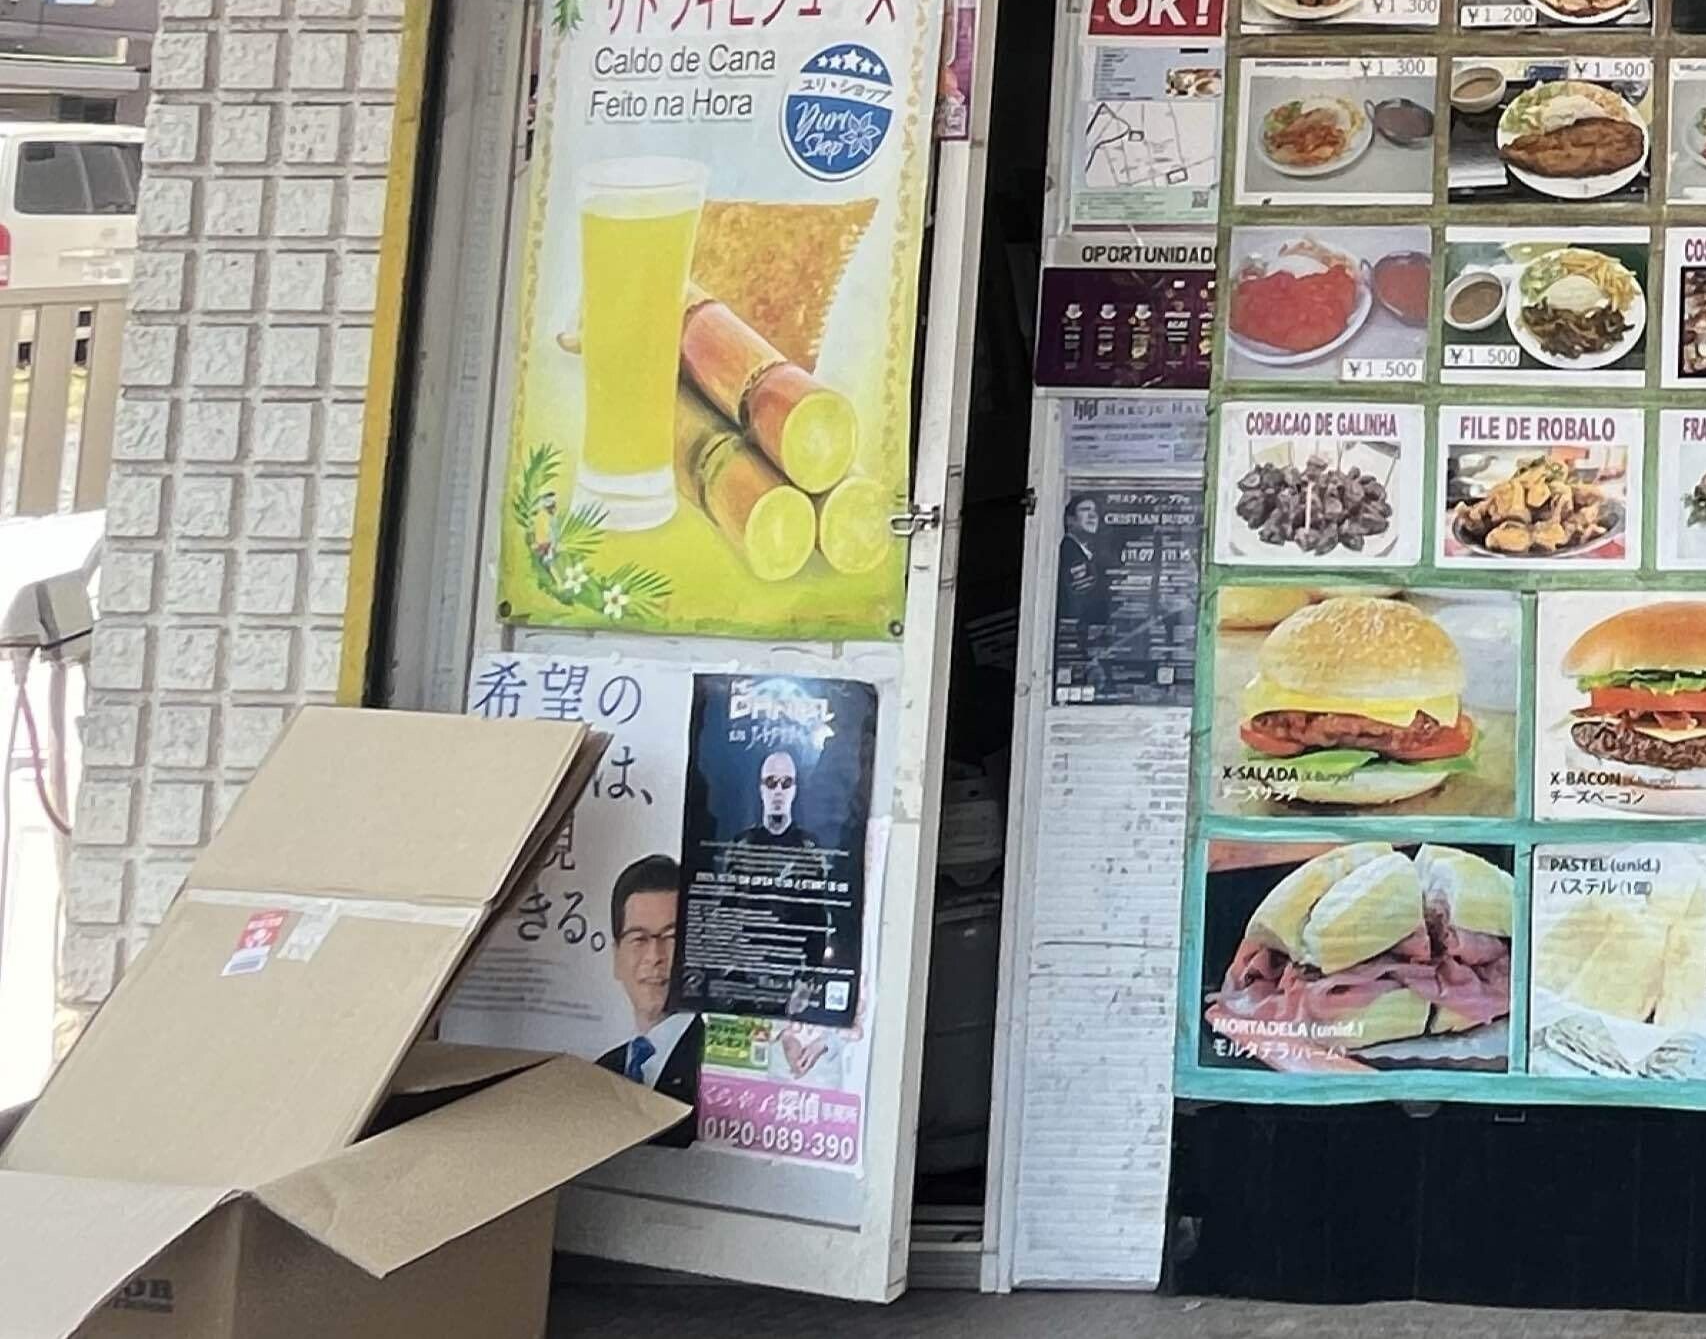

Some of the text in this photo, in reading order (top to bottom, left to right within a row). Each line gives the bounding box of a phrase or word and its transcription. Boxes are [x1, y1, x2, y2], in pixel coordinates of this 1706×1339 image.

[594, 43, 777, 76] Caldo de Cana
[589, 88, 754, 118] Feito na Hora
[803, 131, 843, 166] Shop
[1081, 245, 1216, 264] OPORTUNIDAD
[1314, 412, 1333, 437] DE
[1336, 412, 1398, 439] GALINHA
[1460, 415, 1616, 442] FILE DE ROBALO
[473, 660, 643, 725] 希望の
[1222, 766, 1299, 782] X-SALADA
[1550, 771, 1622, 787] X-BACON
[1550, 857, 1662, 876] PASTEL (unid.)
[1212, 1018, 1309, 1037] MORTADELA
